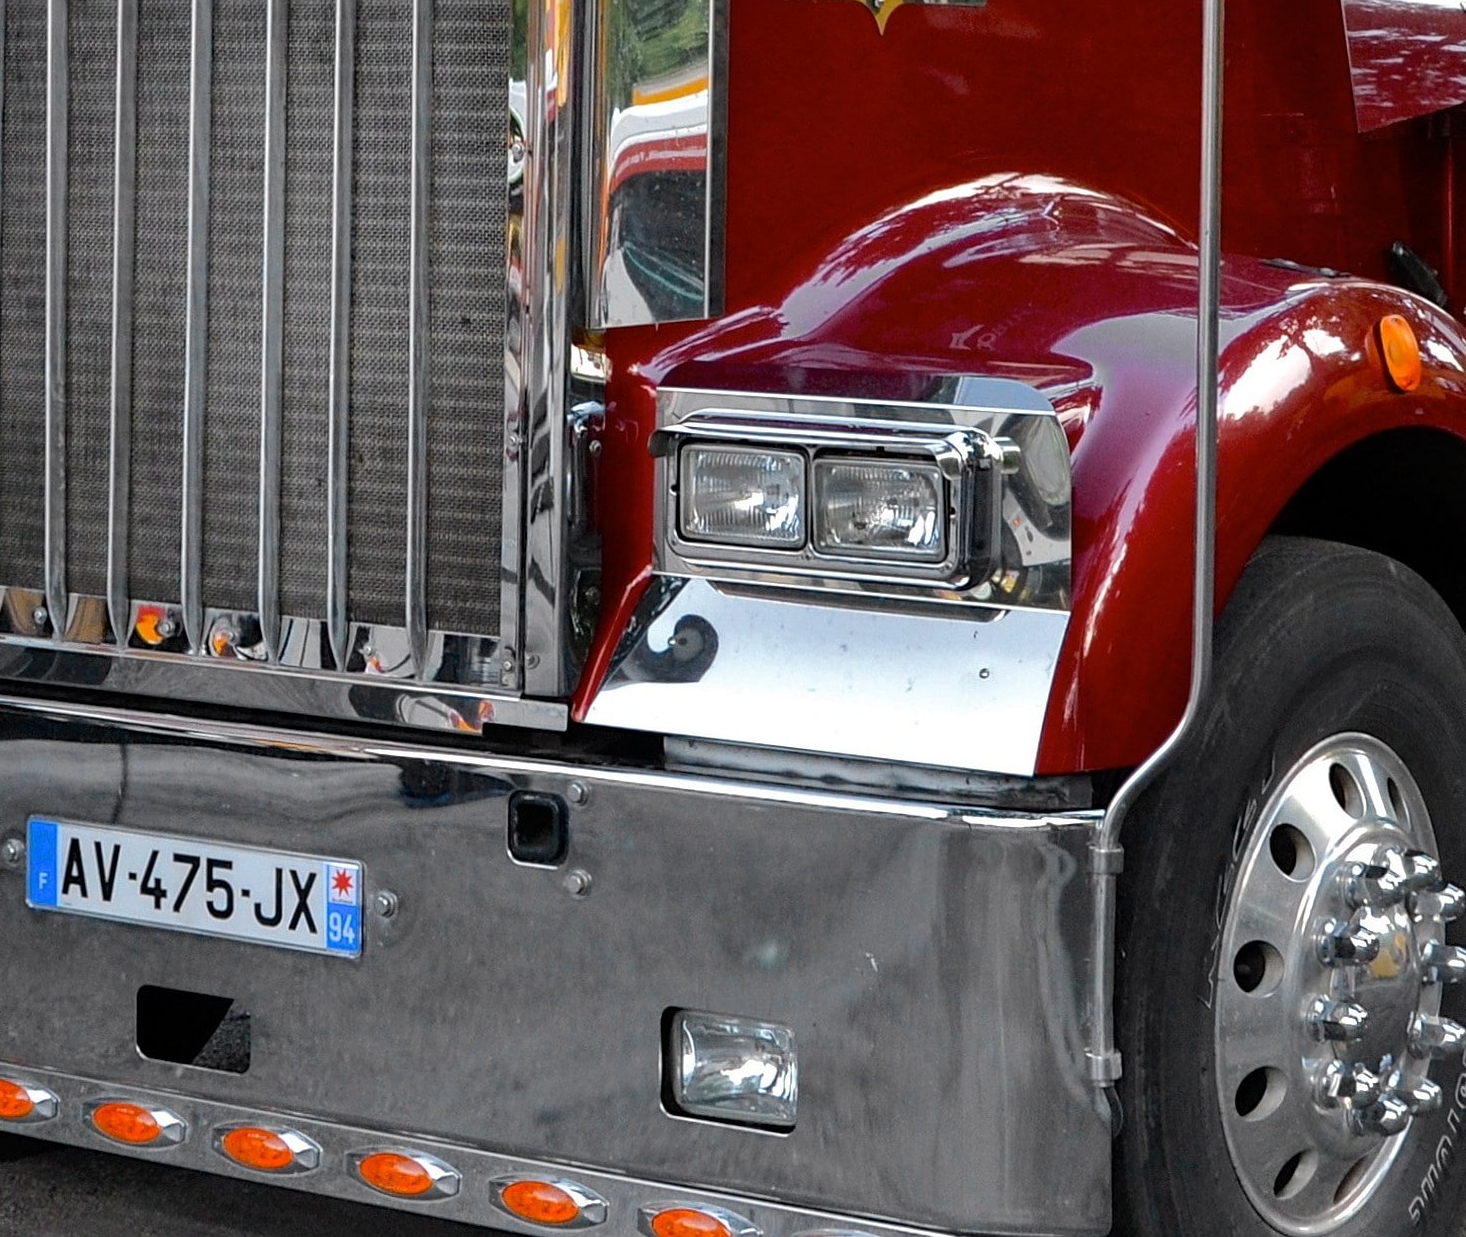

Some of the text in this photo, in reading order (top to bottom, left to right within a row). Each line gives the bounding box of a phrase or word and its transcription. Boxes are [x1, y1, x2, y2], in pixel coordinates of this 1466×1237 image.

[38, 872, 49, 891] F
[61, 836, 318, 934] AV-475-JX
[329, 911, 356, 944] 94
